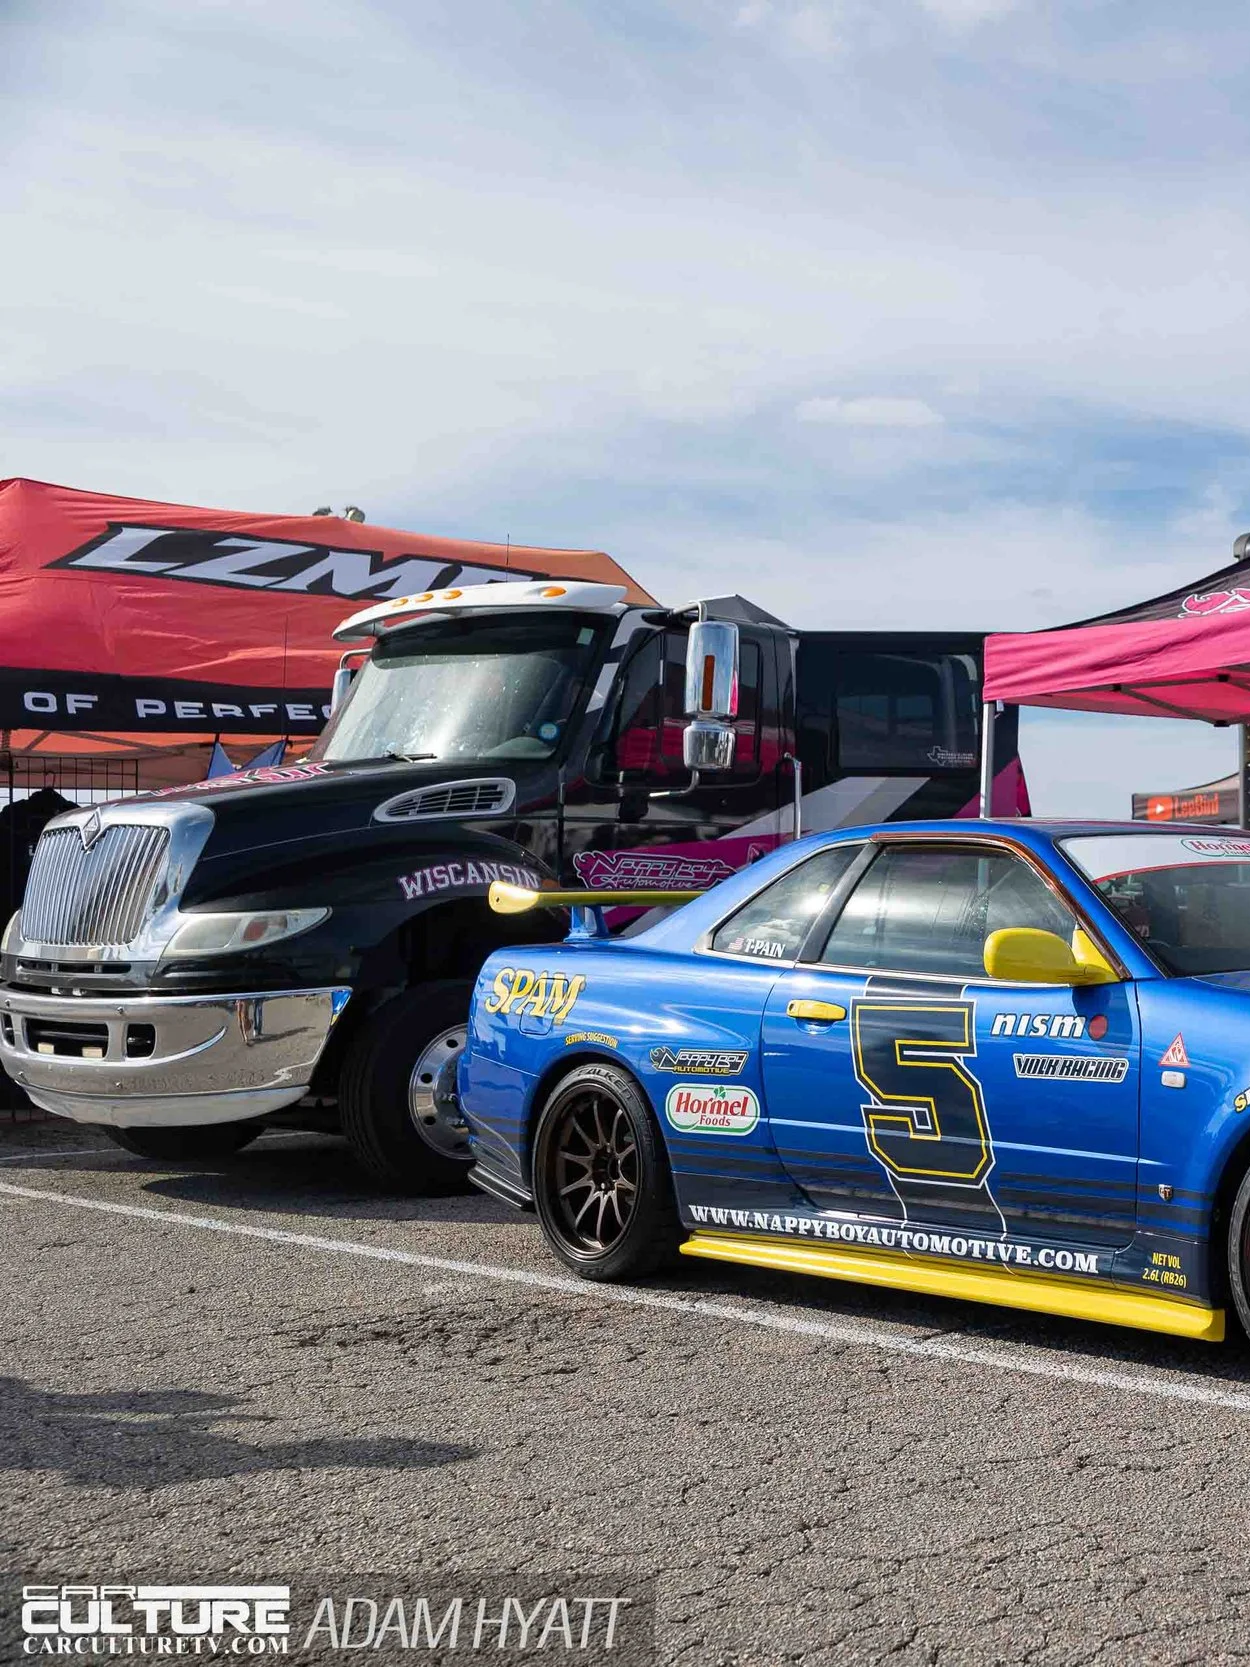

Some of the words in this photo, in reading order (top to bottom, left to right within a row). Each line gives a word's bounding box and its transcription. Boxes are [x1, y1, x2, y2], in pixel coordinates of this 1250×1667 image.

[23, 691, 99, 714] OF
[135, 698, 333, 720] PERFE
[400, 862, 541, 900] WISCANSIN
[485, 967, 587, 1026] SPAM
[1015, 1056, 1060, 1075] VOLK
[1059, 1059, 1126, 1079] RACING
[577, 1068, 634, 1101] FALKEN
[850, 997, 996, 1188] 5
[675, 1092, 749, 1117] Hormel
[700, 1115, 731, 1127] Foods
[689, 1204, 1099, 1274] WWW.NAPPYBOYAUTOMOTIVE.COM
[1152, 1252, 1168, 1266] NET
[1167, 1254, 1181, 1269] VOL
[1142, 1267, 1160, 1282] 2.6L
[1160, 1270, 1187, 1289] (RB26)
